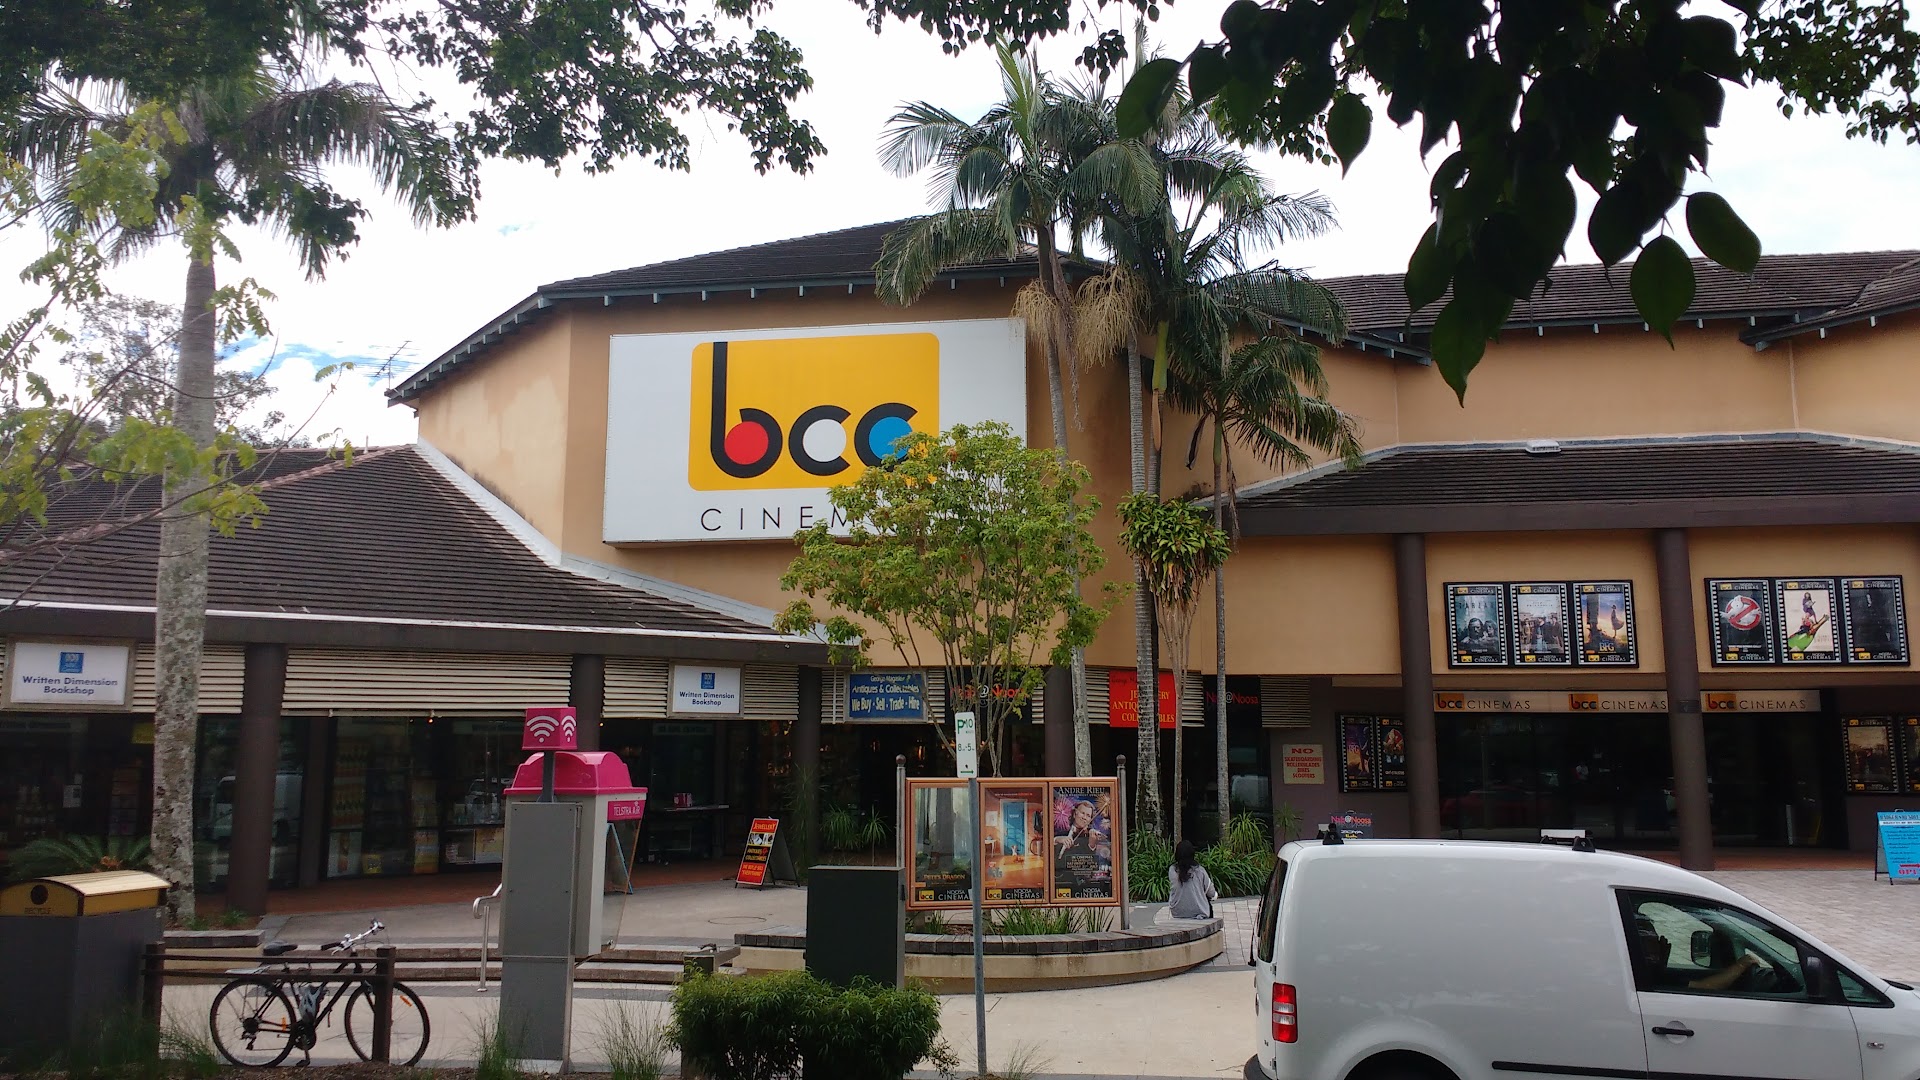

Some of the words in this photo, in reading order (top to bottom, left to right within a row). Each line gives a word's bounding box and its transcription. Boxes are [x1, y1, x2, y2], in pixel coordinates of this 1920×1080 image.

[710, 341, 918, 479] bcc
[700, 505, 860, 532] CINEM
[22, 676, 60, 684] Written
[64, 677, 117, 686] Dimension
[852, 684, 878, 694] Antiques
[879, 684, 884, 693] &
[44, 686, 94, 695] Bookshop
[1130, 690, 1169, 700] JEERY
[852, 698, 860, 711] We
[861, 697, 871, 713] Buy
[876, 697, 885, 710] Sell
[890, 696, 904, 711] Trade
[908, 696, 920, 710] Hire
[1437, 694, 1462, 709] bcc
[1467, 700, 1530, 710] CINEMAS
[1570, 694, 1597, 710] bcc
[1601, 700, 1667, 710] CINEMAS
[1708, 694, 1735, 710] bcc
[1740, 700, 1806, 710] CINEMAS
[614, 806, 631, 815] TELSTRA
